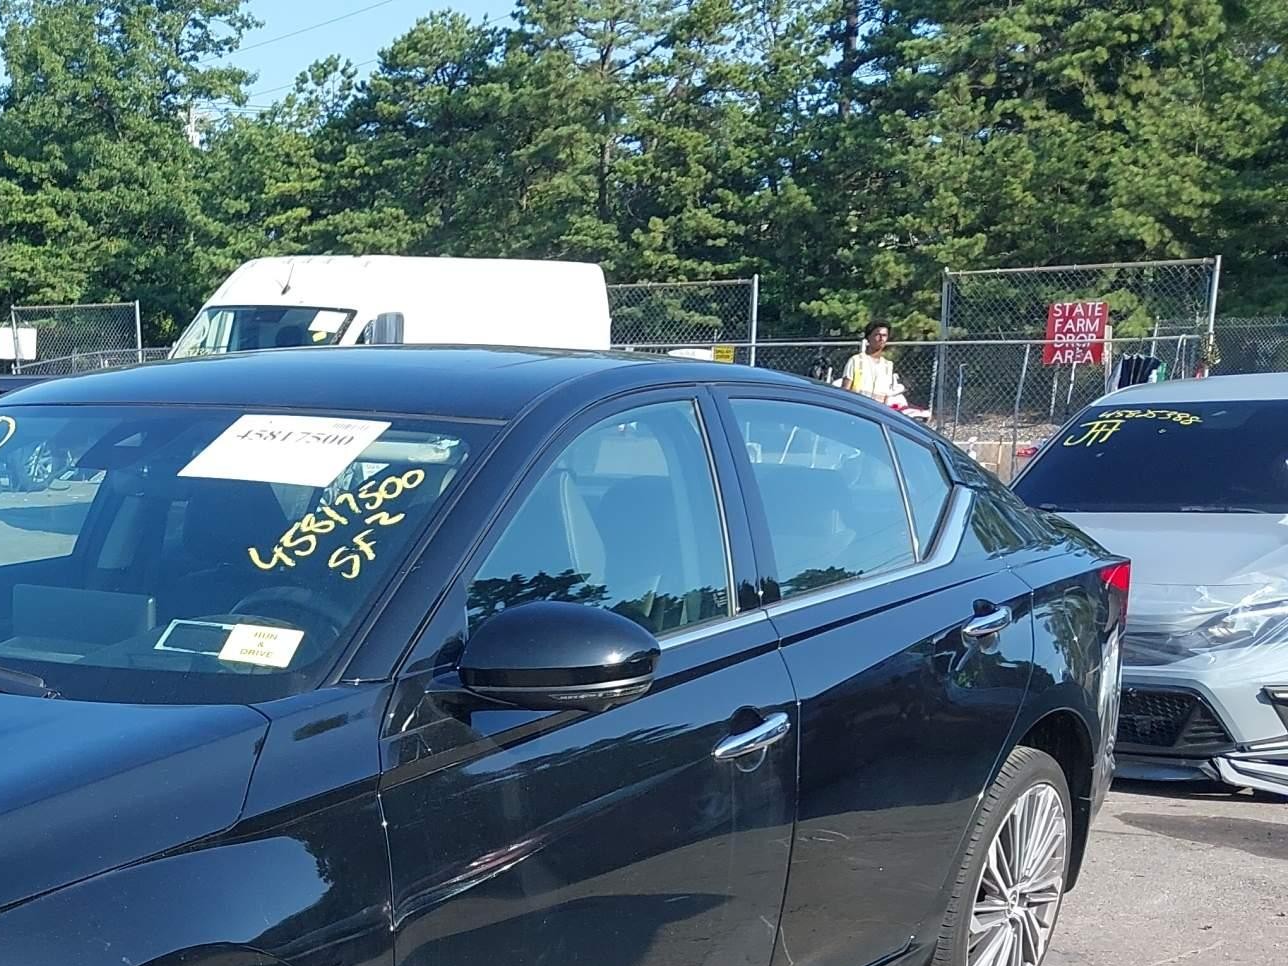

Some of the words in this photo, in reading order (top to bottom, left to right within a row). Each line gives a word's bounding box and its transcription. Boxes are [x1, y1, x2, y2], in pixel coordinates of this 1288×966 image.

[1052, 301, 1104, 317] STATE
[1053, 318, 1100, 333] FARM
[1053, 333, 1097, 348] DROP
[1050, 349, 1095, 364] AREA
[237, 429, 355, 446] 45817500
[248, 469, 425, 569] 45817500
[239, 648, 274, 658] DRIVE
